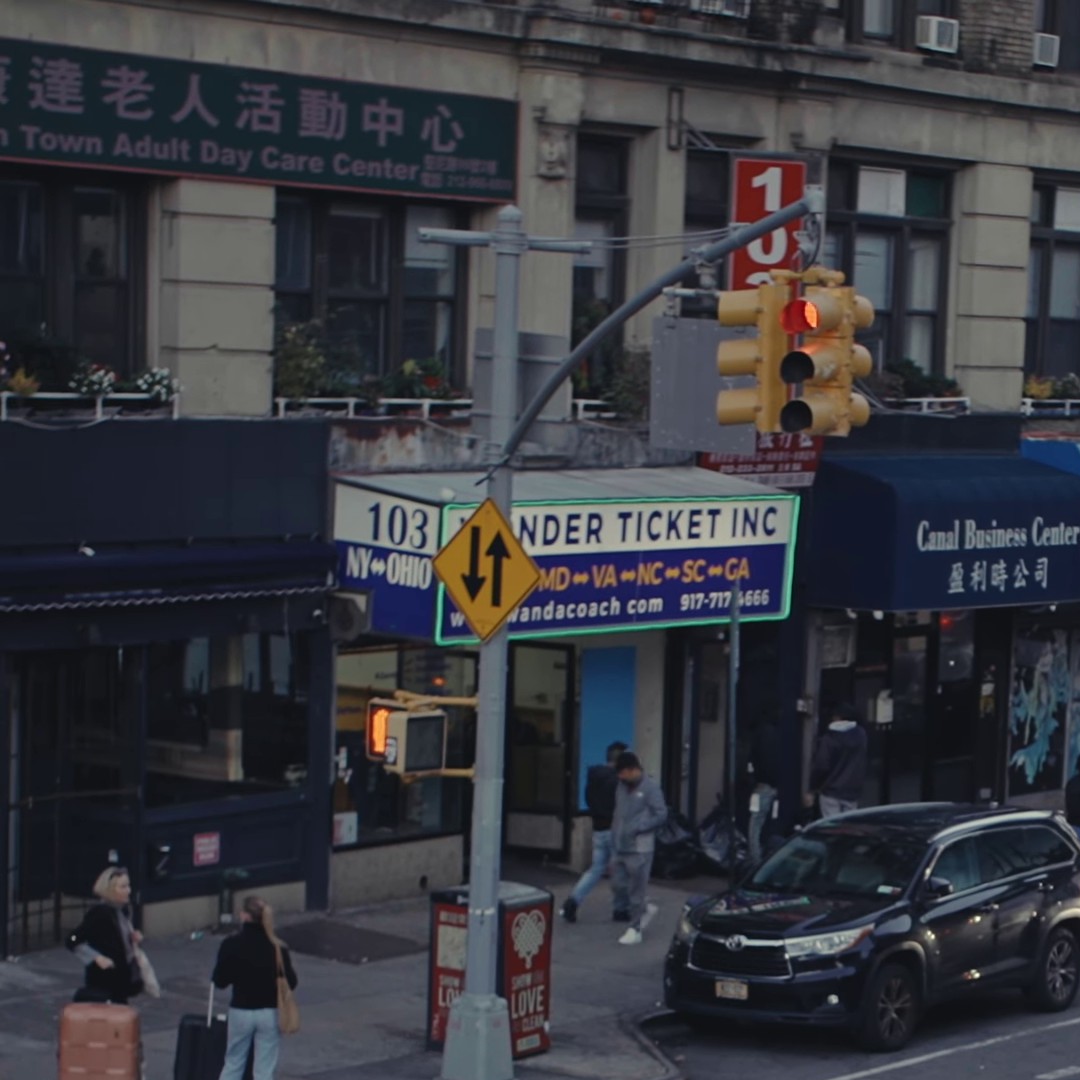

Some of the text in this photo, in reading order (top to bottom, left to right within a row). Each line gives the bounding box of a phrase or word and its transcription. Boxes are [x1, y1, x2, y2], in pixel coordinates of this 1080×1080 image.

[0, 55, 465, 153] 達老人活動中心
[19, 124, 103, 155] Town
[113, 132, 191, 163] Adult
[201, 139, 253, 173] Day
[261, 146, 324, 174] Care
[332, 152, 419, 181] Center
[368, 503, 428, 550] 103
[618, 509, 721, 543] TICKET
[732, 506, 778, 538] INC
[916, 515, 1080, 552] Canal Business Center
[346, 546, 433, 591] NY OHIO
[592, 563, 618, 588] VA
[637, 561, 664, 586] NC
[681, 558, 708, 583] SC
[724, 557, 751, 581] GA
[947, 556, 1048, 594] 盈利時公司
[511, 985, 545, 1020] LOVE
